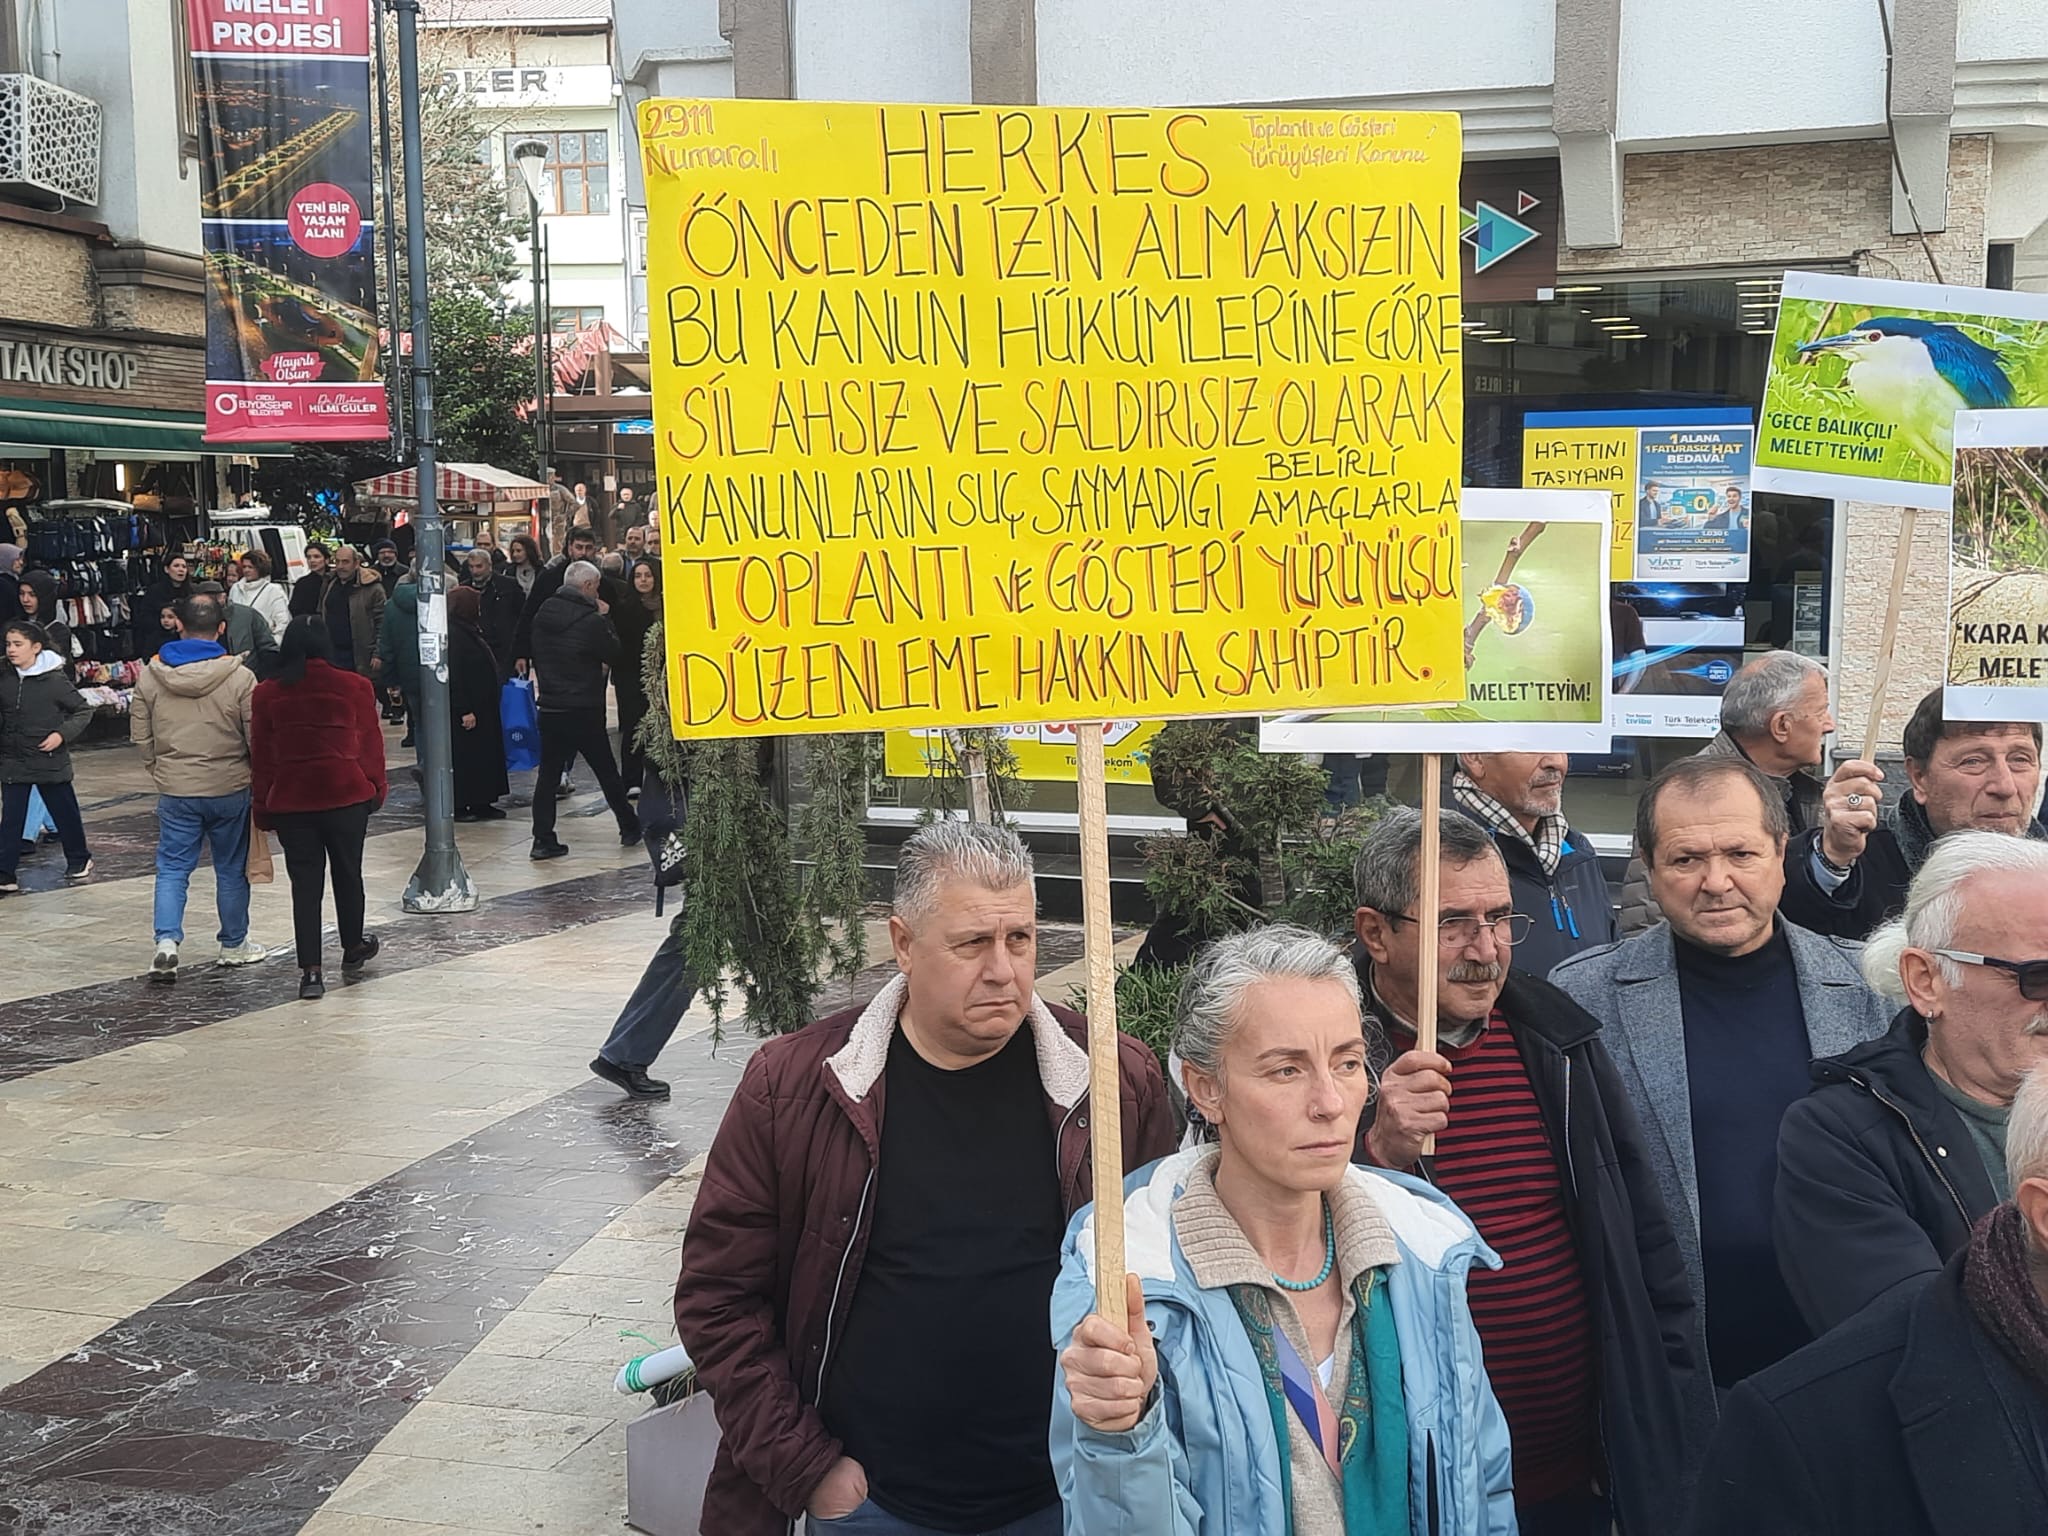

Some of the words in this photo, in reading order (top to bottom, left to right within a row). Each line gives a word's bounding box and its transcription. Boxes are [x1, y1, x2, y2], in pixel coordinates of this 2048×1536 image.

[212, 18, 342, 48] PROJESİ
[643, 105, 714, 139] 2911
[1339, 114, 1397, 138] Gösteri
[645, 138, 778, 176] Numaralı
[877, 108, 1210, 197] HERKES
[1355, 139, 1430, 165] Kanunu
[296, 200, 326, 214] YENİ
[328, 200, 351, 214] BİR
[301, 215, 347, 228] YAŞAM
[304, 228, 345, 239] ALANI
[679, 192, 964, 281] ÖNCEDEN
[983, 195, 1102, 282] İZİN
[1122, 200, 1446, 281] ALMAKSIZIN
[667, 285, 748, 367] BU
[768, 288, 970, 368] KANUN
[997, 285, 1357, 367] HÜKÜMLERİNE
[1365, 283, 1460, 365] GÖRE
[67, 347, 139, 389] SHOP
[275, 369, 312, 381] Olsun
[668, 372, 919, 463] SİLAHSIZ
[928, 379, 1010, 455] VE
[1020, 376, 1265, 455] SALDIRISIZ
[1273, 368, 1456, 449] OLARAK
[1535, 439, 1627, 460] HATTINI
[1679, 434, 1721, 443] ALANA
[1711, 443, 1744, 454] HAT
[1770, 437, 1884, 463] MELET'TEYİM!
[1256, 445, 1404, 482] BELİRLİ
[1666, 453, 1726, 464] BEDAVA!
[1530, 465, 1625, 486] TAŞIYANA
[666, 466, 938, 545] KANUNLARIN
[947, 468, 1025, 540] SUÇ
[1032, 457, 1225, 534] SAYMADIĞI
[1249, 478, 1460, 530] AMAÇLARLA
[681, 544, 975, 631] TOPLANTI
[992, 559, 1035, 614] VE
[1044, 529, 1246, 620] GÖSTERİ
[1256, 520, 1458, 614] YÜRÜYÜŞÜ
[678, 632, 999, 727] DÜZENLEME
[1012, 627, 1207, 704] HAKKINA
[1215, 614, 1433, 697] SAHİPTİR.
[1979, 657, 2048, 679] MELE
[1470, 677, 1591, 702] MELET'TEYİM!
[1664, 715, 1681, 723] Türk
[1685, 715, 1720, 724] Telekom
